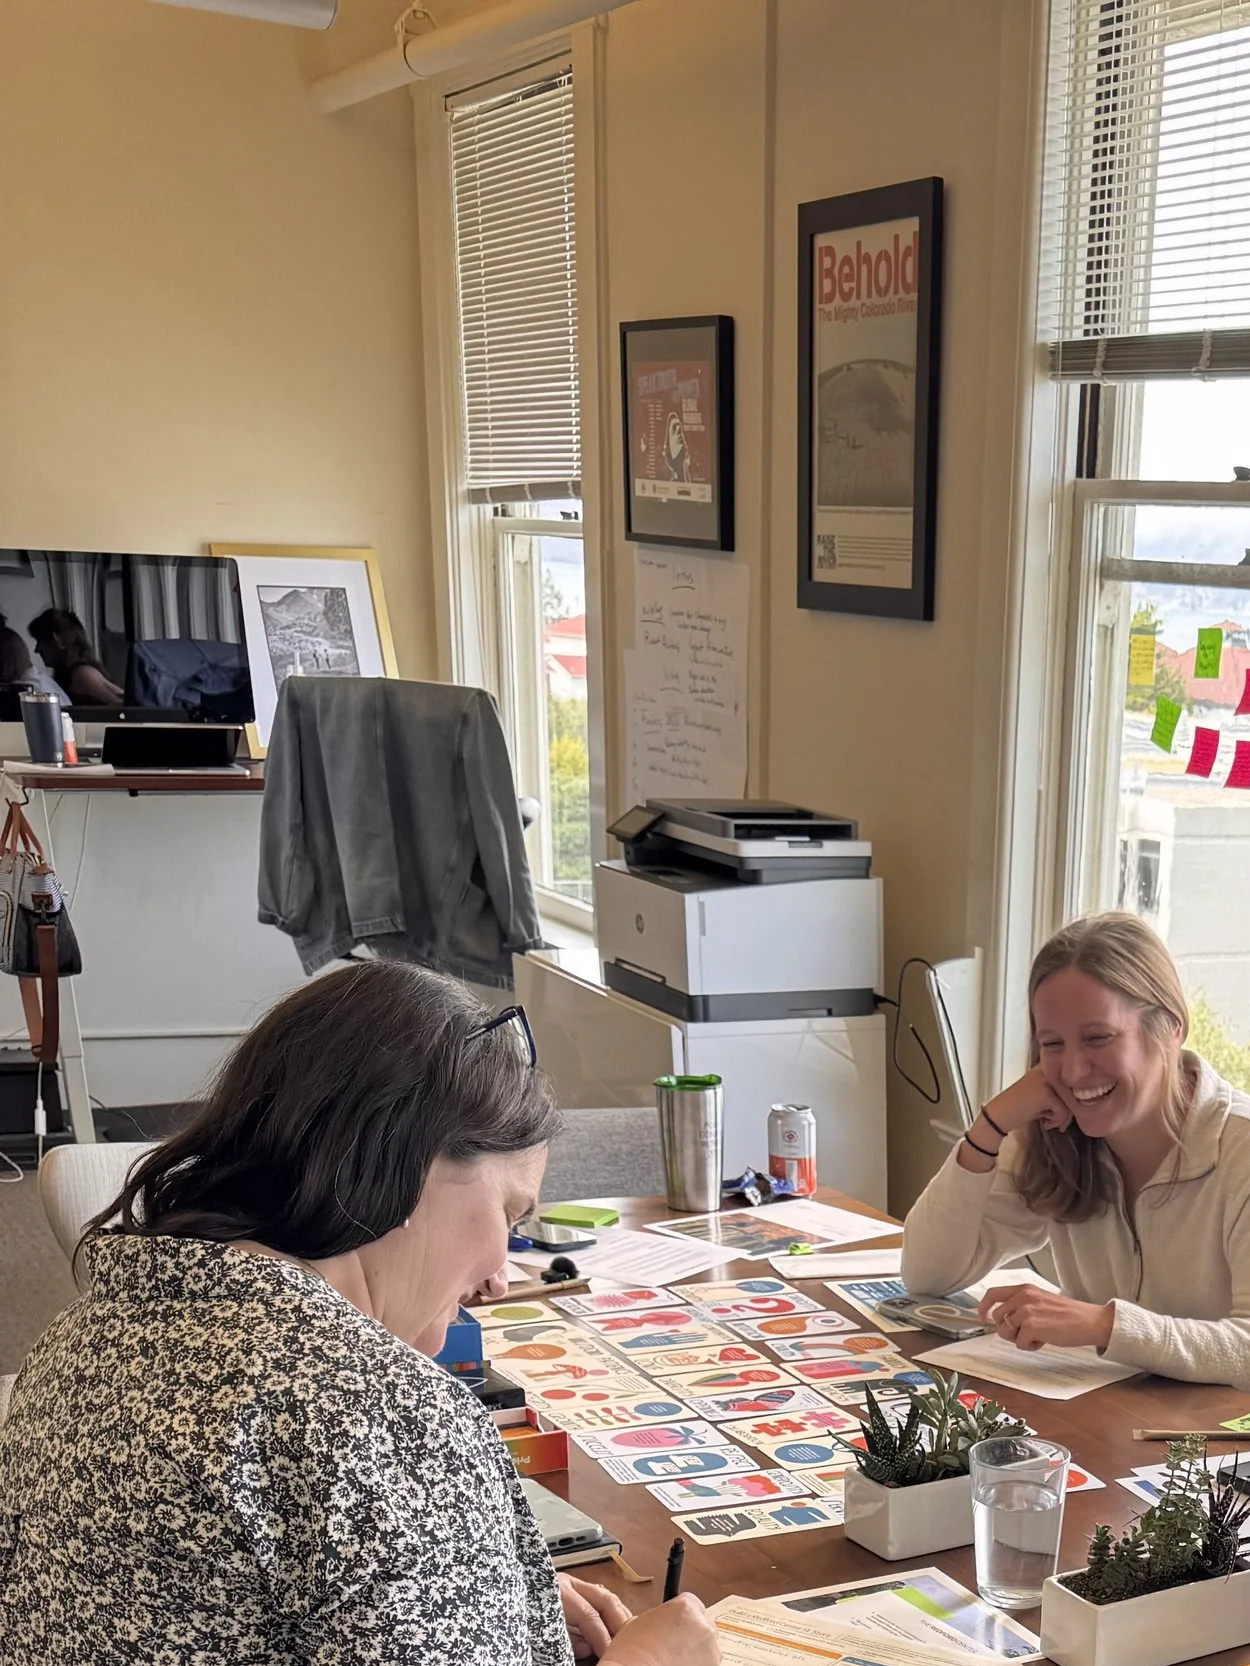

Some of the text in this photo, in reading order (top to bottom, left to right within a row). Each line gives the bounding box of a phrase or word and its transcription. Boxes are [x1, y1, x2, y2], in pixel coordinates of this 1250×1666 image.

[818, 231, 918, 304] Behold
[834, 305, 858, 323] Mighty
[860, 301, 895, 318] Colorado
[720, 1448, 755, 1468] RESPECT
